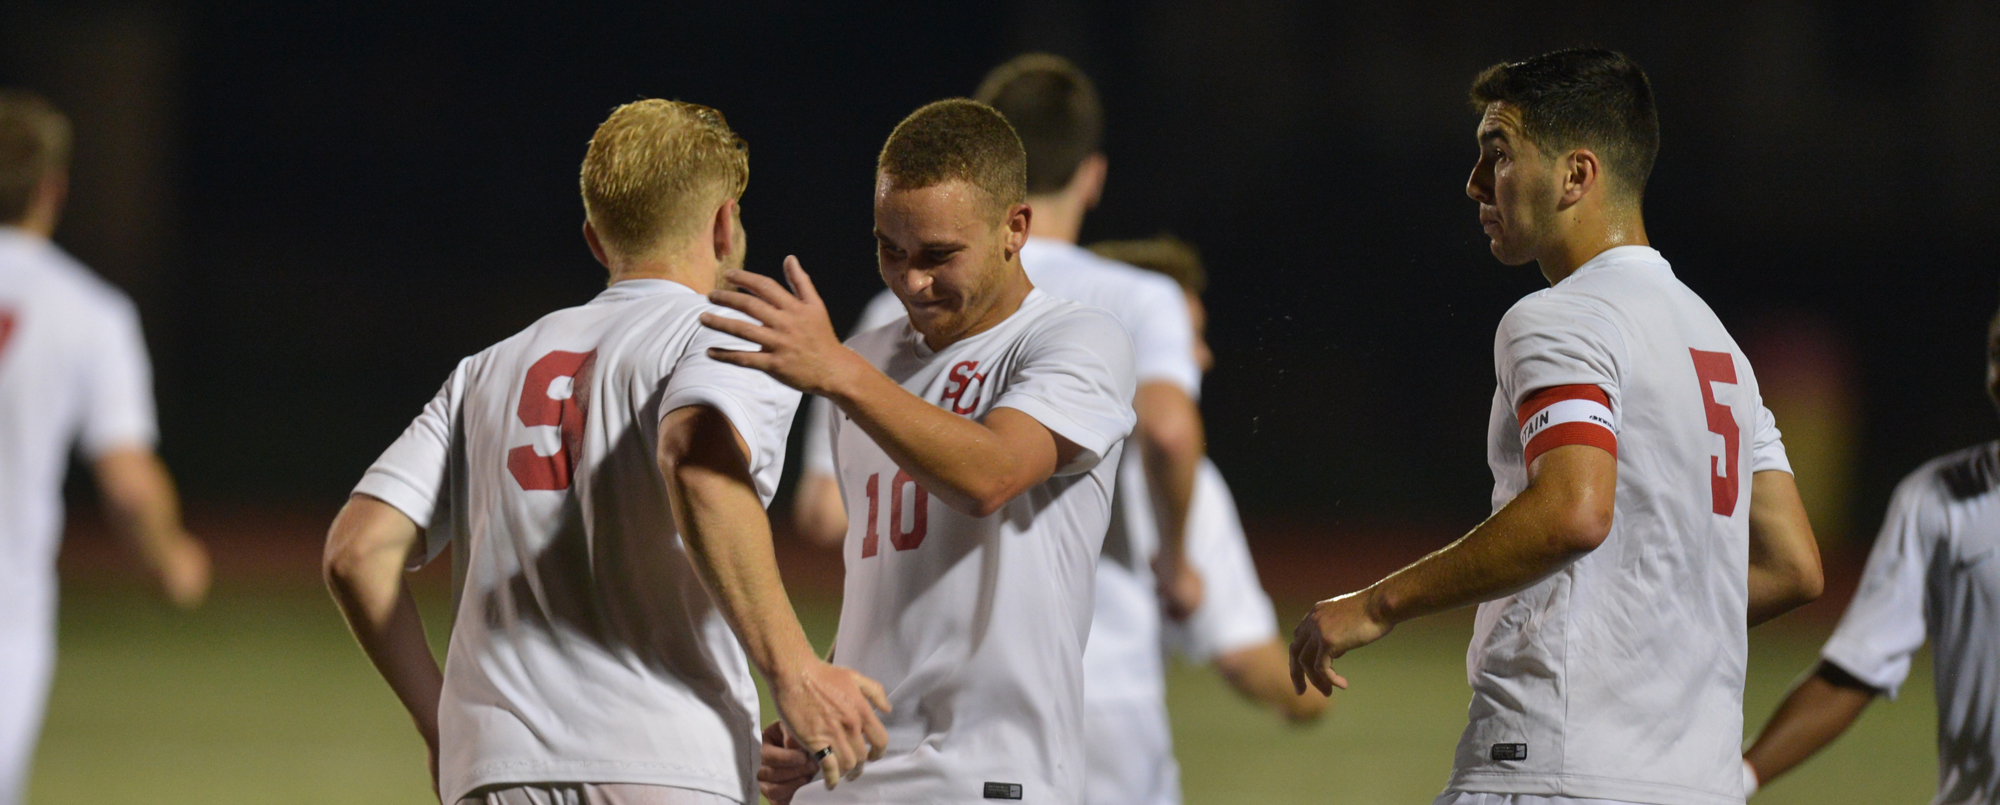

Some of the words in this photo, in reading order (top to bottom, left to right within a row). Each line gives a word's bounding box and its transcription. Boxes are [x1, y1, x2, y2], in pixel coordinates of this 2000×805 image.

[507, 347, 598, 491] 9
[941, 361, 988, 415] SC
[1521, 410, 1549, 444] TAIN
[1688, 347, 1739, 517] 5
[862, 468, 928, 559] 10
